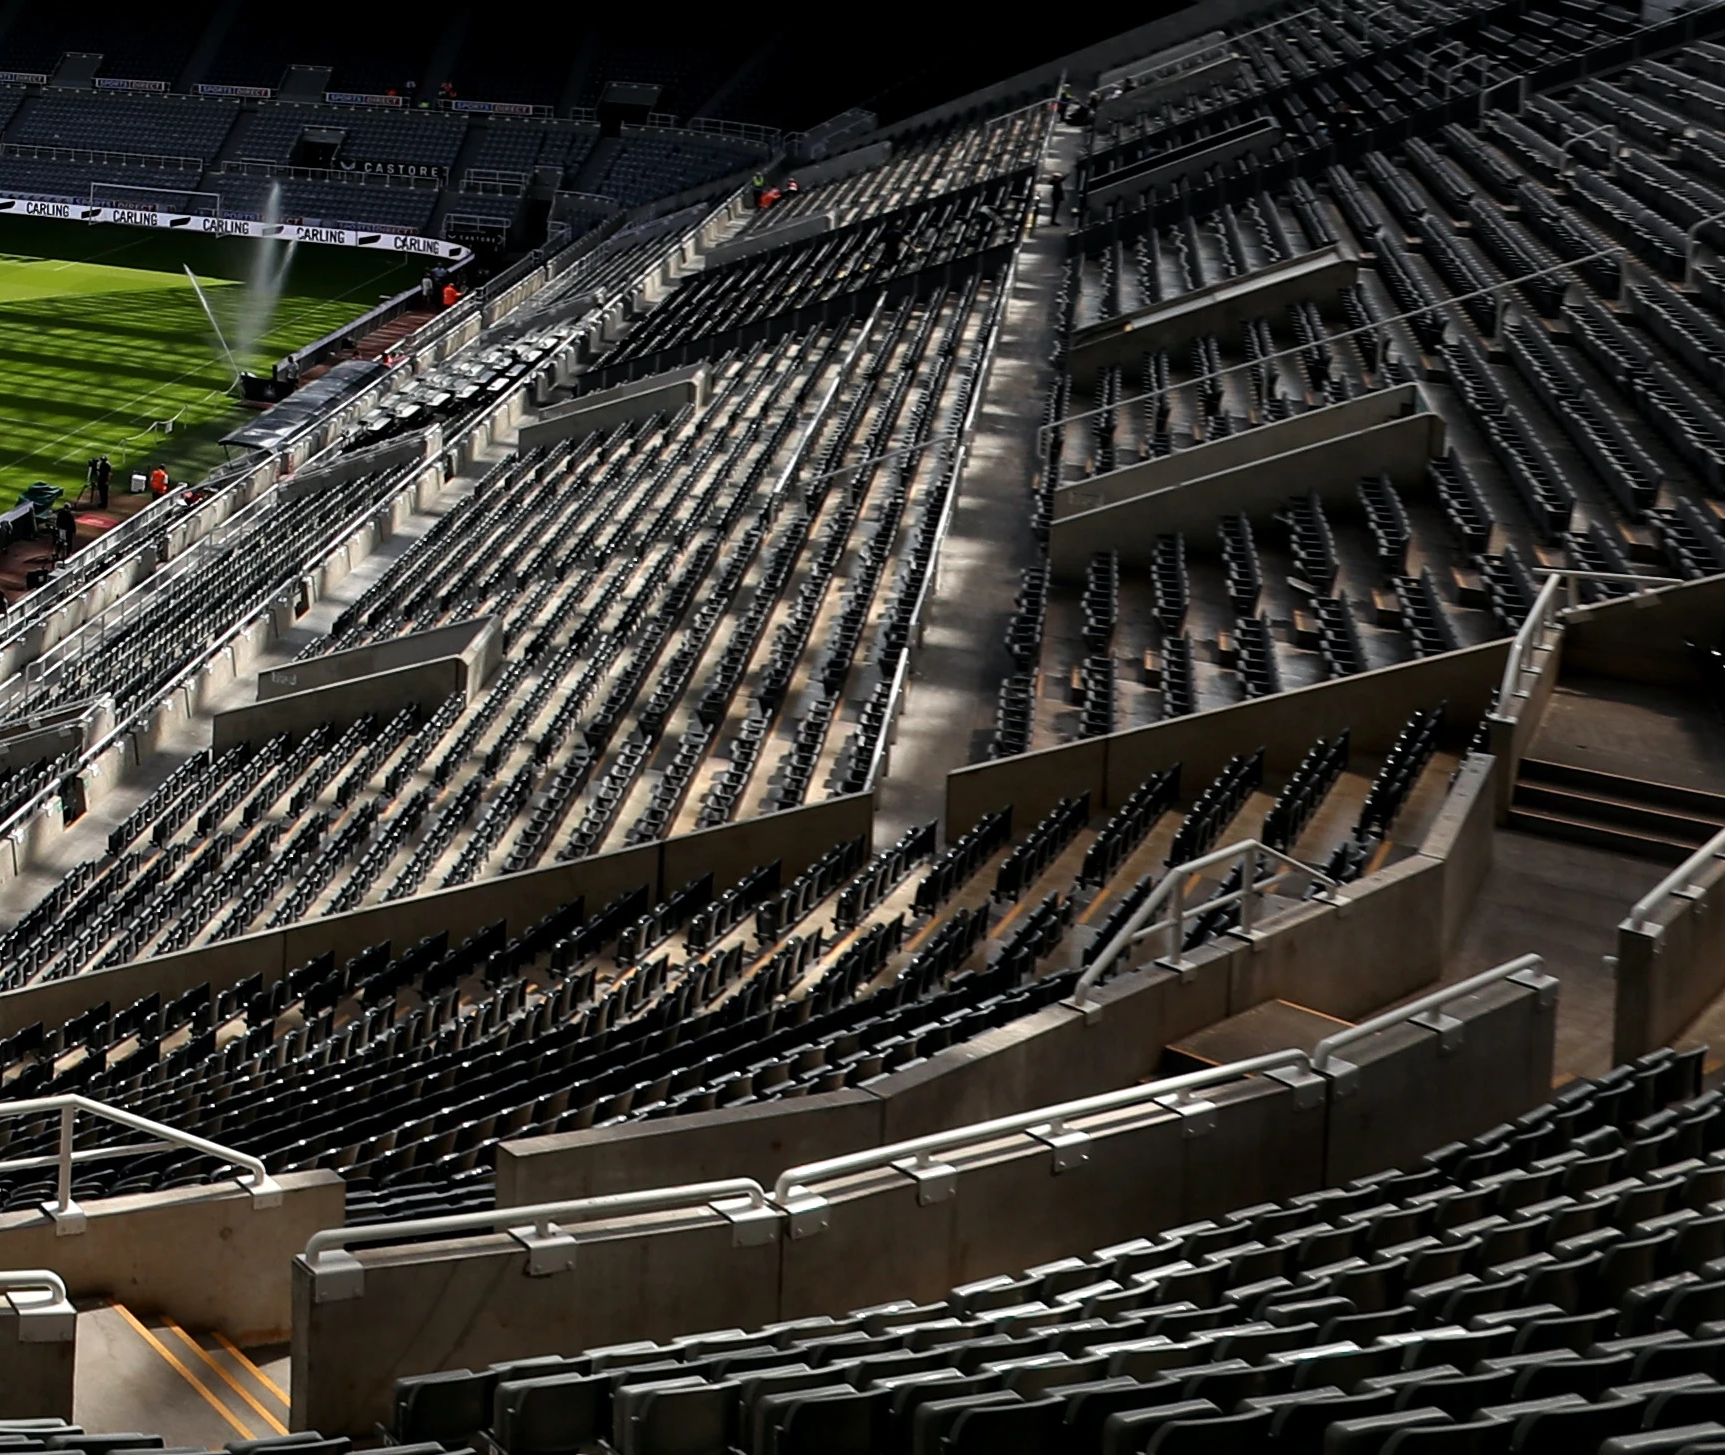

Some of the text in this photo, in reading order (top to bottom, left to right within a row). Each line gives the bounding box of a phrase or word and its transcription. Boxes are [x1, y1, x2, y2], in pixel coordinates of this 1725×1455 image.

[495, 103, 531, 114] DIRECT
[363, 162, 439, 177] CASTORE
[26, 202, 69, 217] CARLING
[113, 210, 157, 226] CARLING
[203, 218, 249, 235] CARLING
[296, 227, 345, 244] CARLING
[394, 236, 439, 254] CARLING
